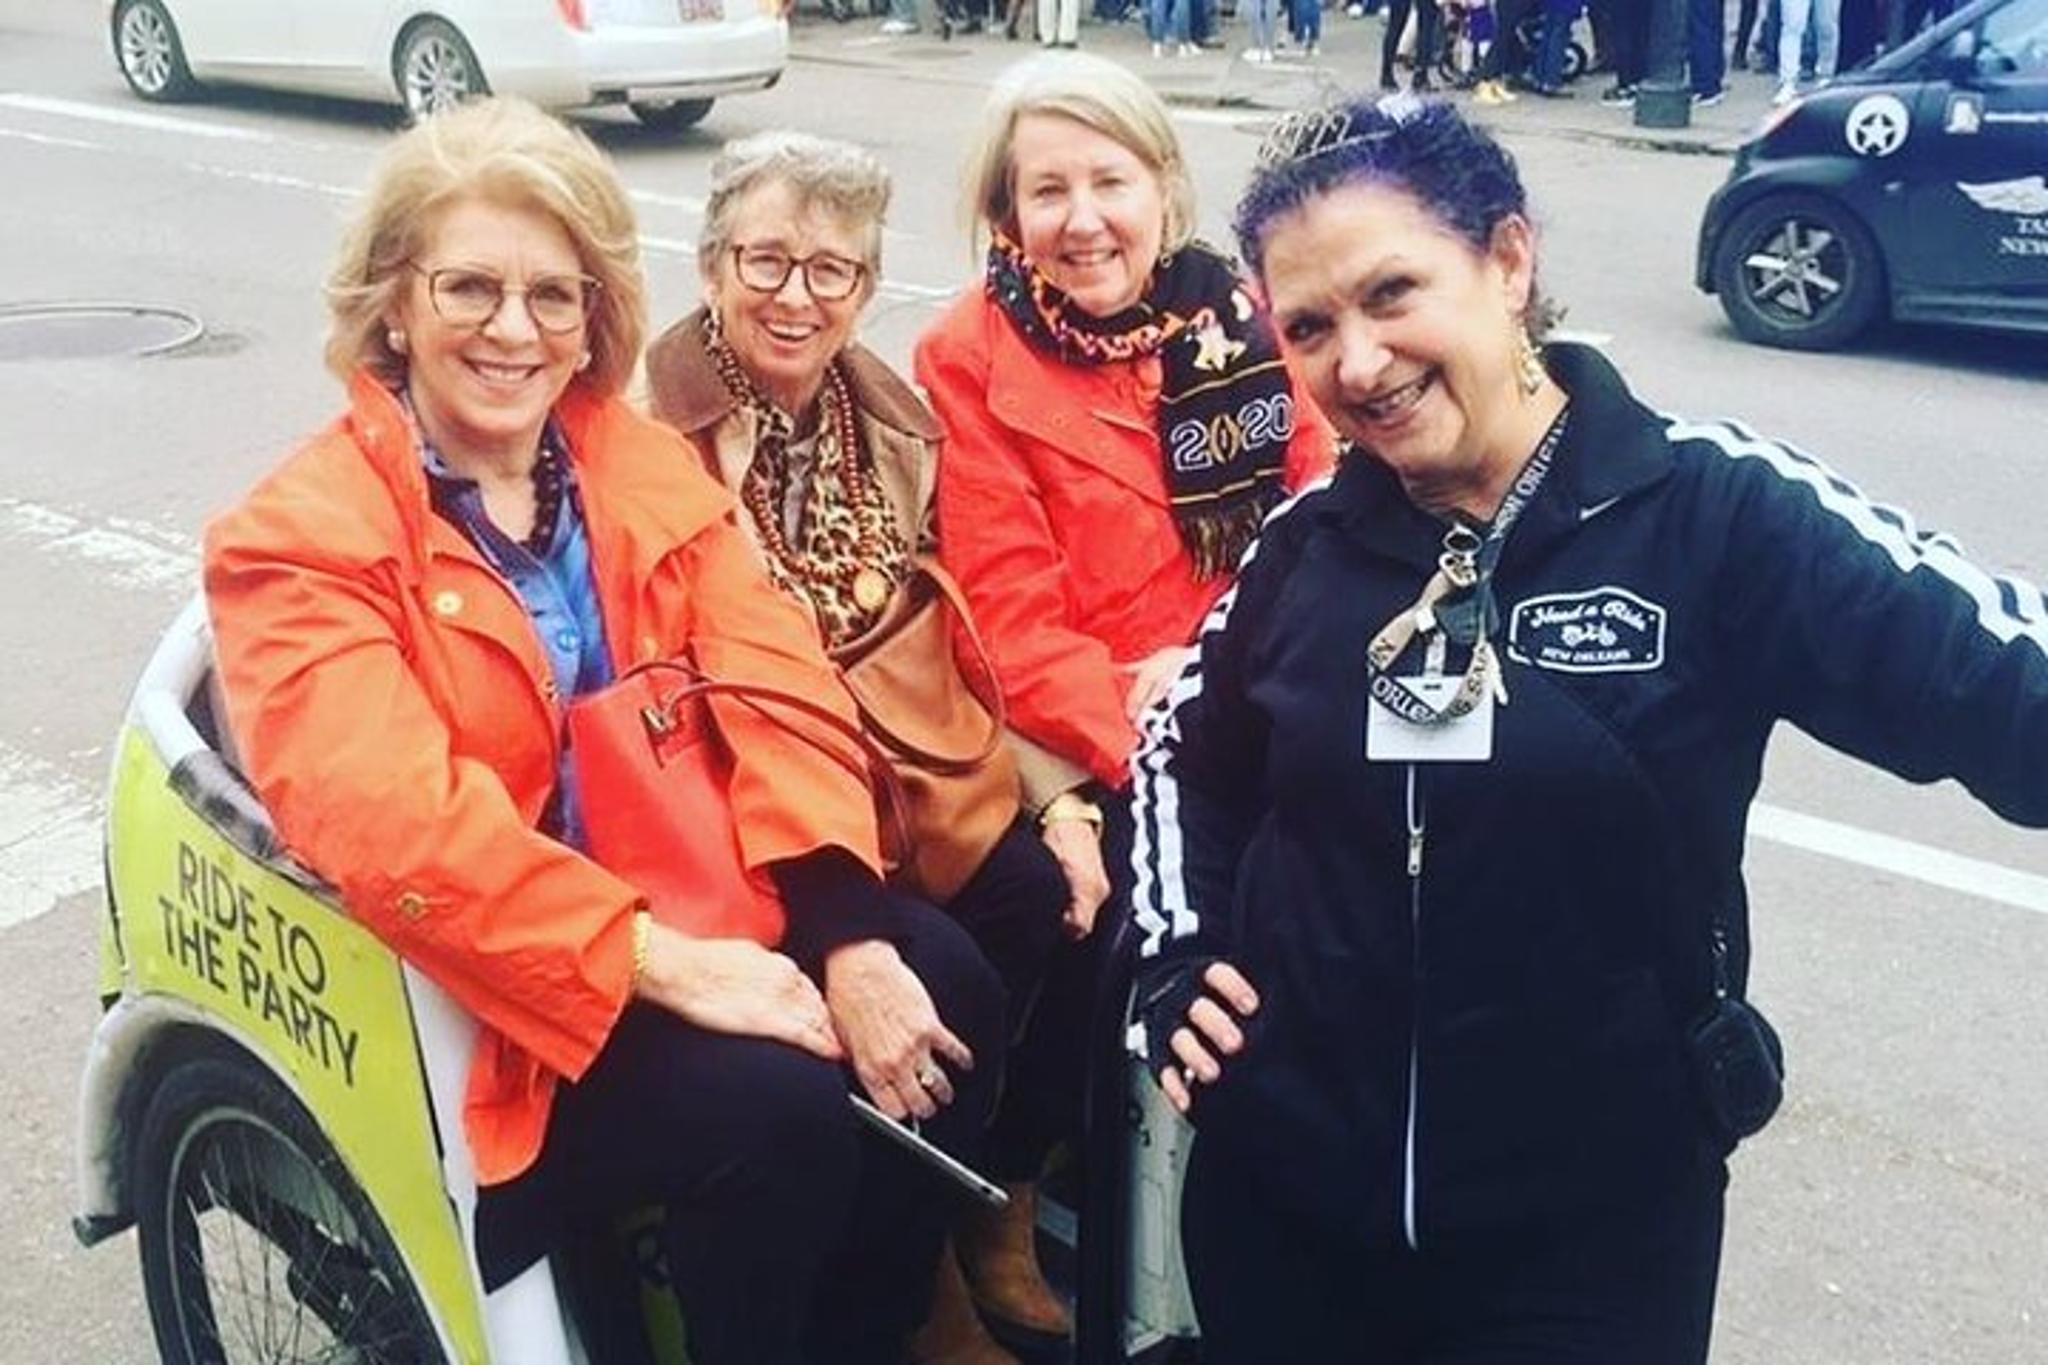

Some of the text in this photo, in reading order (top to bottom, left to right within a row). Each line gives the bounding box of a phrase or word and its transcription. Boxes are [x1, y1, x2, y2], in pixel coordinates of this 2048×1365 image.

[1170, 394, 1294, 470] 2020
[159, 896, 358, 1087] THE PARTY
[179, 842, 325, 996] RIDE TO
